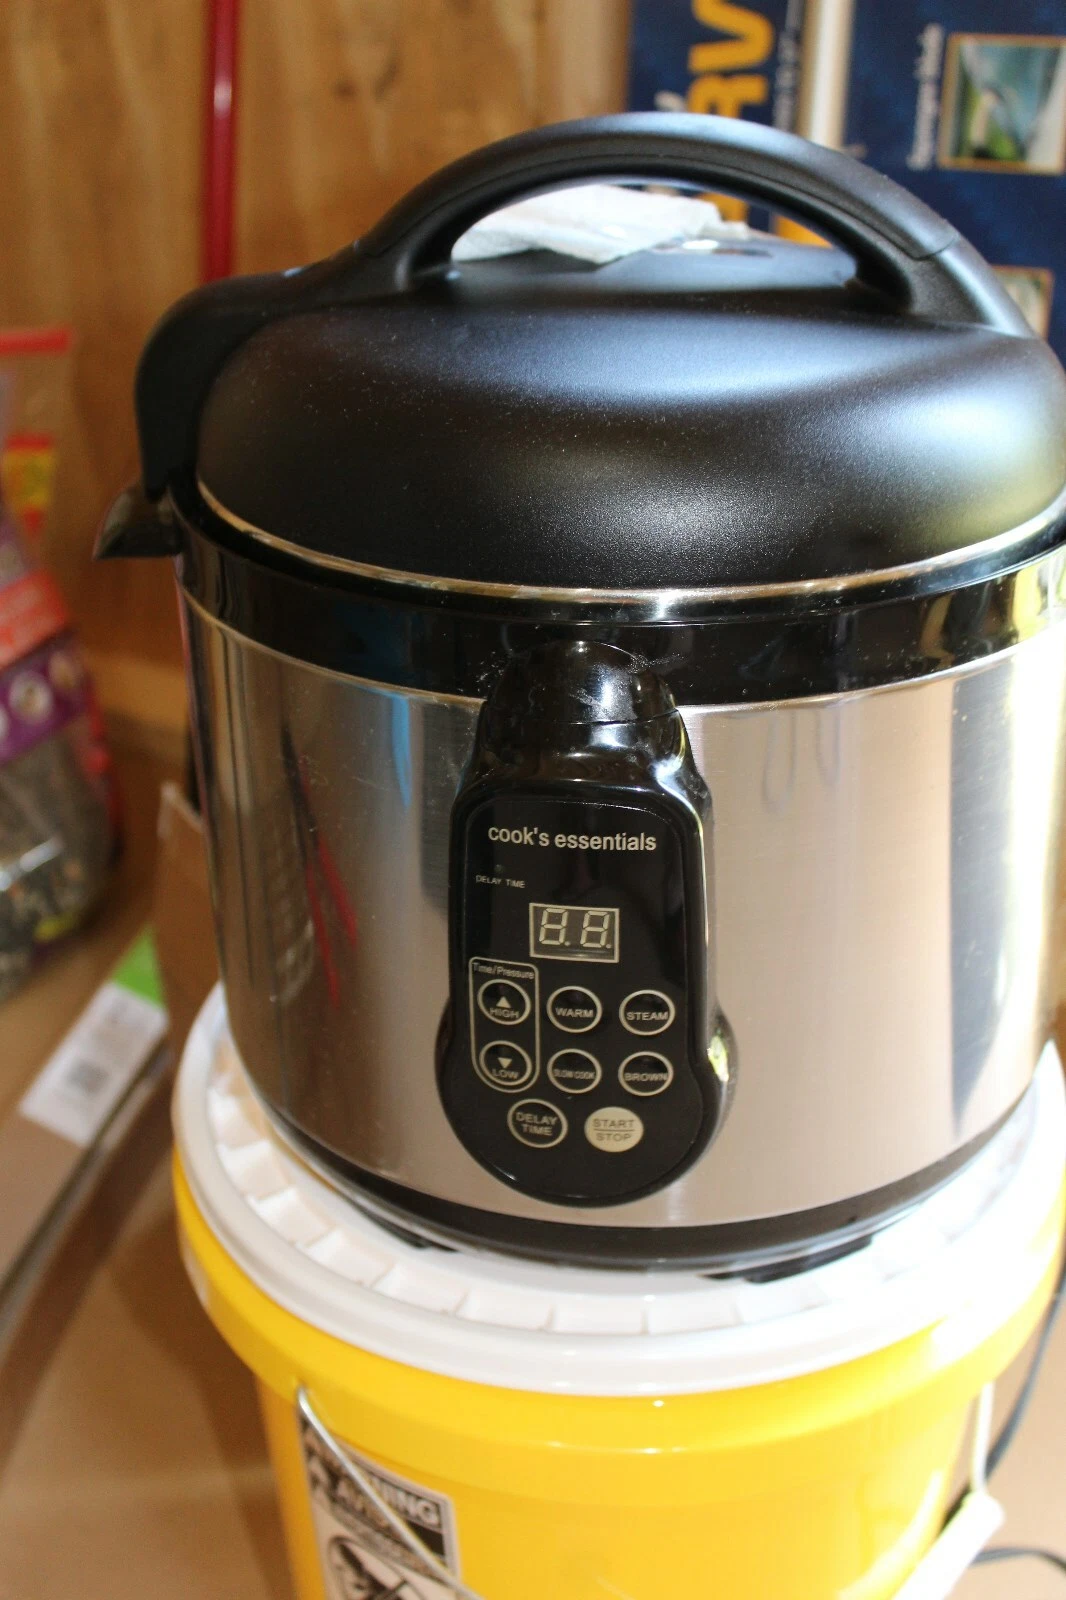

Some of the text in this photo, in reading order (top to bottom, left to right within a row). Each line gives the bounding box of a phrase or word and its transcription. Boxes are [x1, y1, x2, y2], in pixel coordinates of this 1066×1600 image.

[488, 826, 657, 851] cook's essentials
[475, 875, 526, 889] DELAY TIME
[472, 962, 535, 979] Time/Pressure
[489, 1007, 519, 1019] HIGH
[555, 1007, 594, 1018] WARM
[626, 1011, 668, 1021] STEAM
[491, 1068, 519, 1079] LOW
[553, 1068, 596, 1080] SLOW COOK
[624, 1072, 669, 1082] BROWN
[515, 1111, 558, 1126] DELAY
[593, 1118, 634, 1128] START
[521, 1123, 553, 1137] TIME
[595, 1132, 631, 1142] STOP
